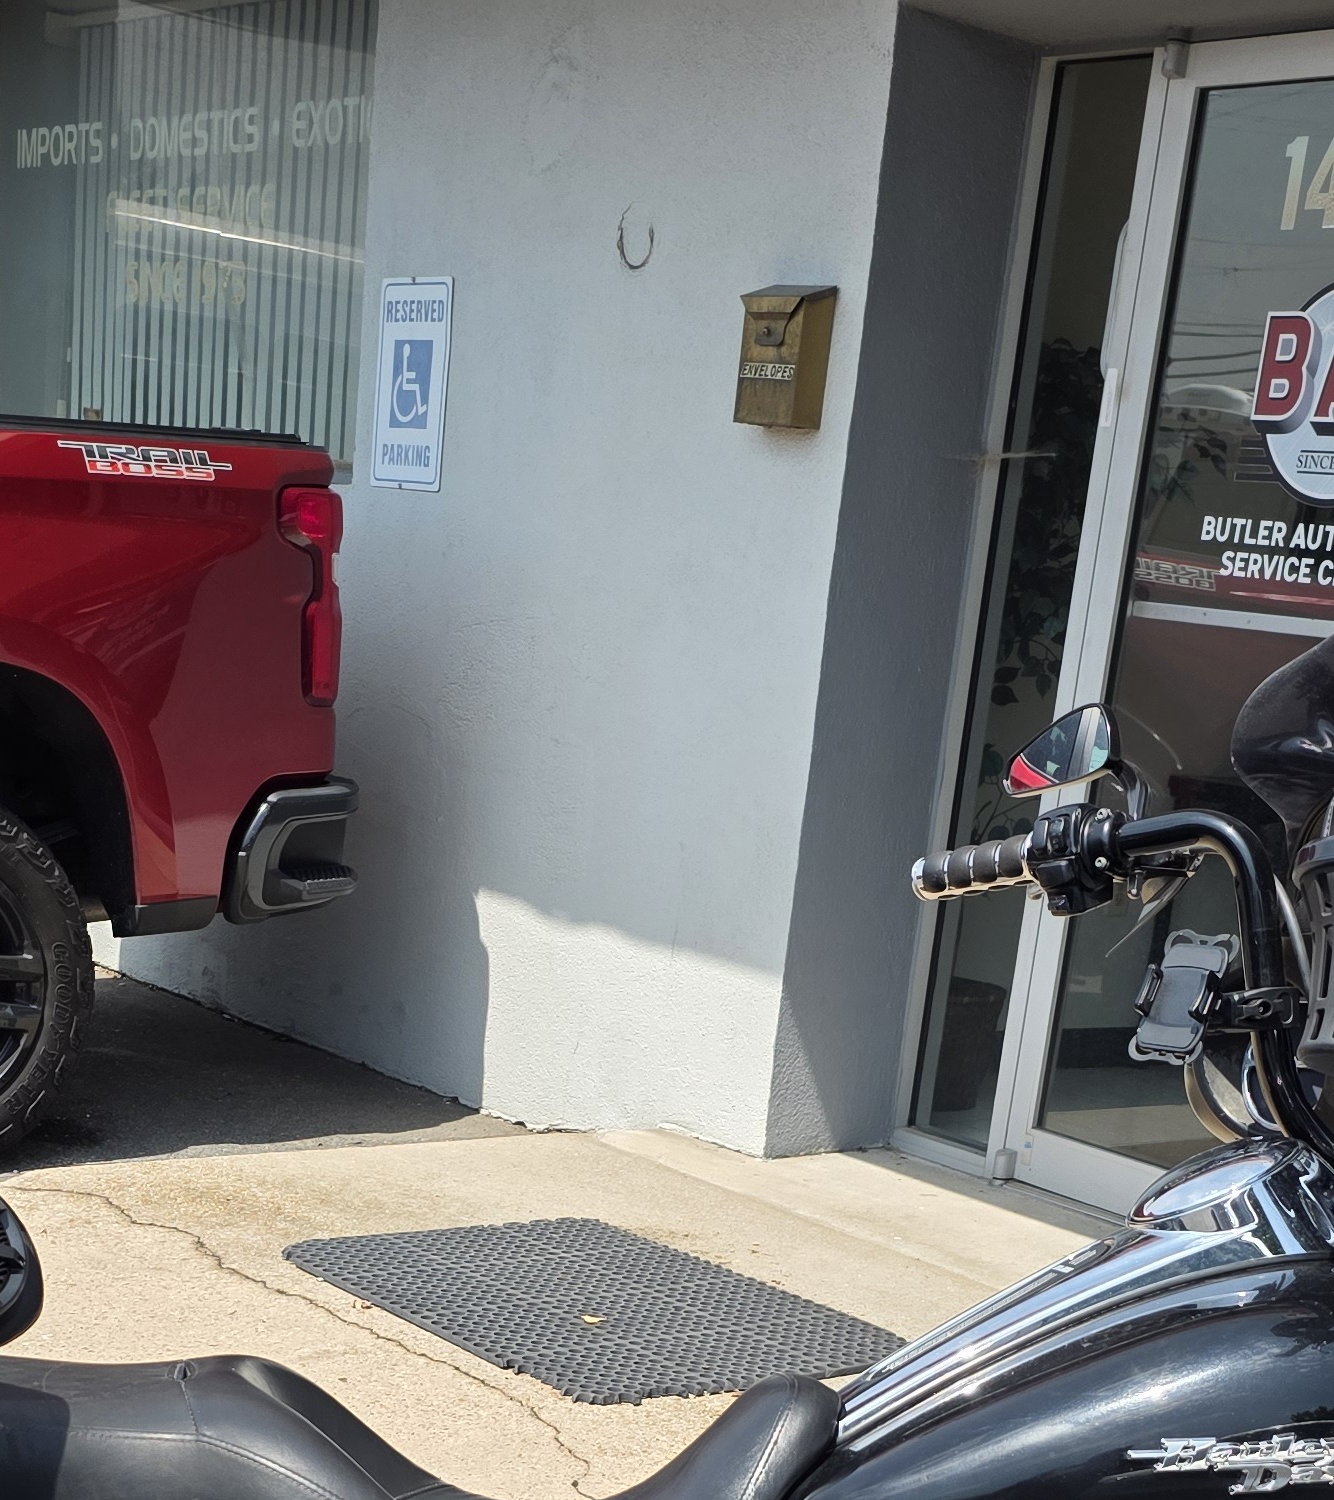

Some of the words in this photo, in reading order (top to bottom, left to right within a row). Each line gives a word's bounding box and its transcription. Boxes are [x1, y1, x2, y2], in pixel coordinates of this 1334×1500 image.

[17, 121, 103, 169] IMPORTS
[130, 106, 260, 161] DOMESTICS
[386, 299, 445, 324] RESERVED
[741, 363, 795, 379] ENVELOPES
[57, 440, 232, 470] TRAIL
[381, 443, 430, 468] PARKING
[88, 460, 215, 481] BOSS
[1200, 515, 1287, 548] BUTLER
[1218, 550, 1315, 584] SERVICE
[3, 940, 73, 1114] GOODYEAR
